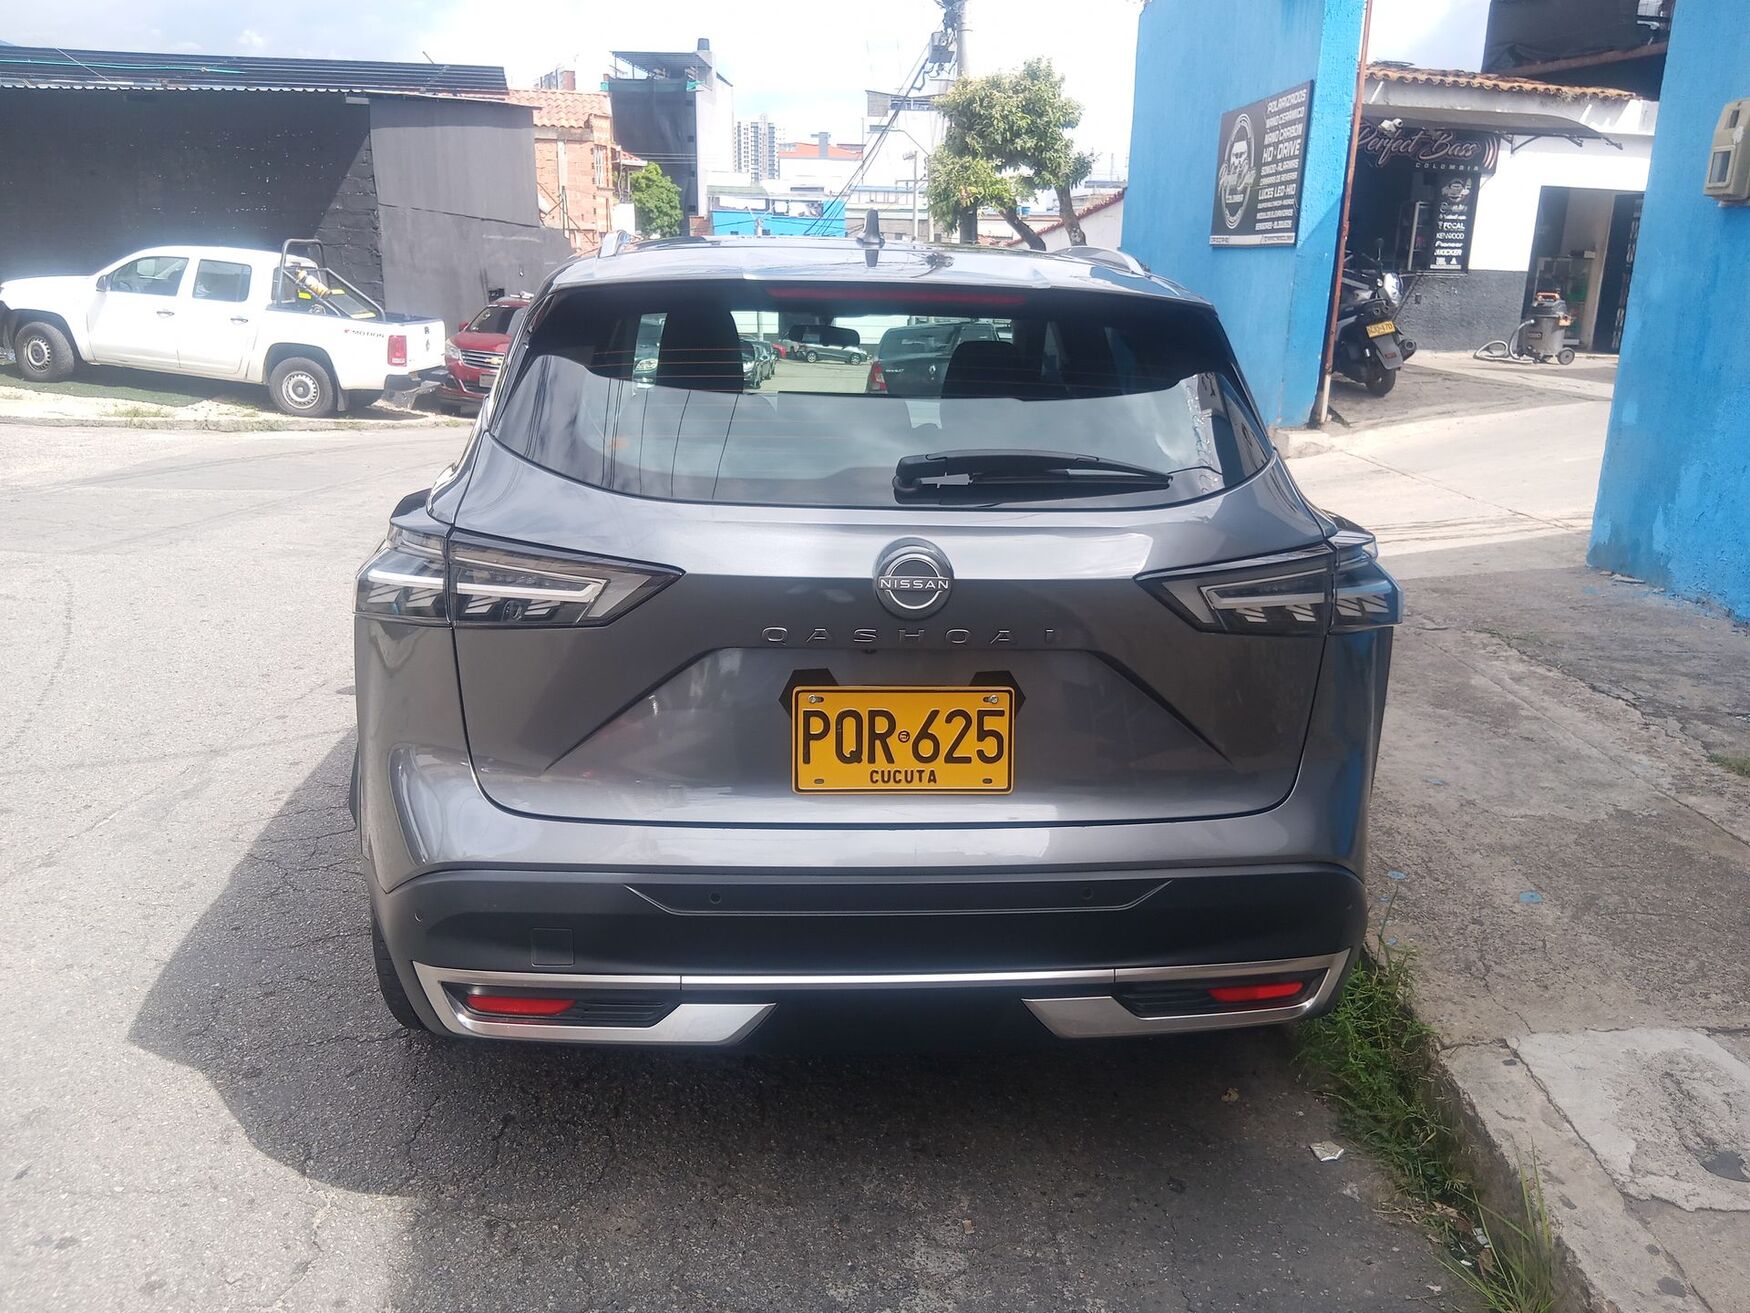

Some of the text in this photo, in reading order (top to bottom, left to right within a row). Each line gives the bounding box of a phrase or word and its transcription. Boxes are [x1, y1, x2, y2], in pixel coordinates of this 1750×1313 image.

[1419, 130, 1478, 160] Bass
[1415, 162, 1479, 171] COLOMBIA
[879, 578, 950, 590] NISSAN
[761, 625, 1056, 646] QASHQAI
[869, 768, 937, 784] CUCUTA
